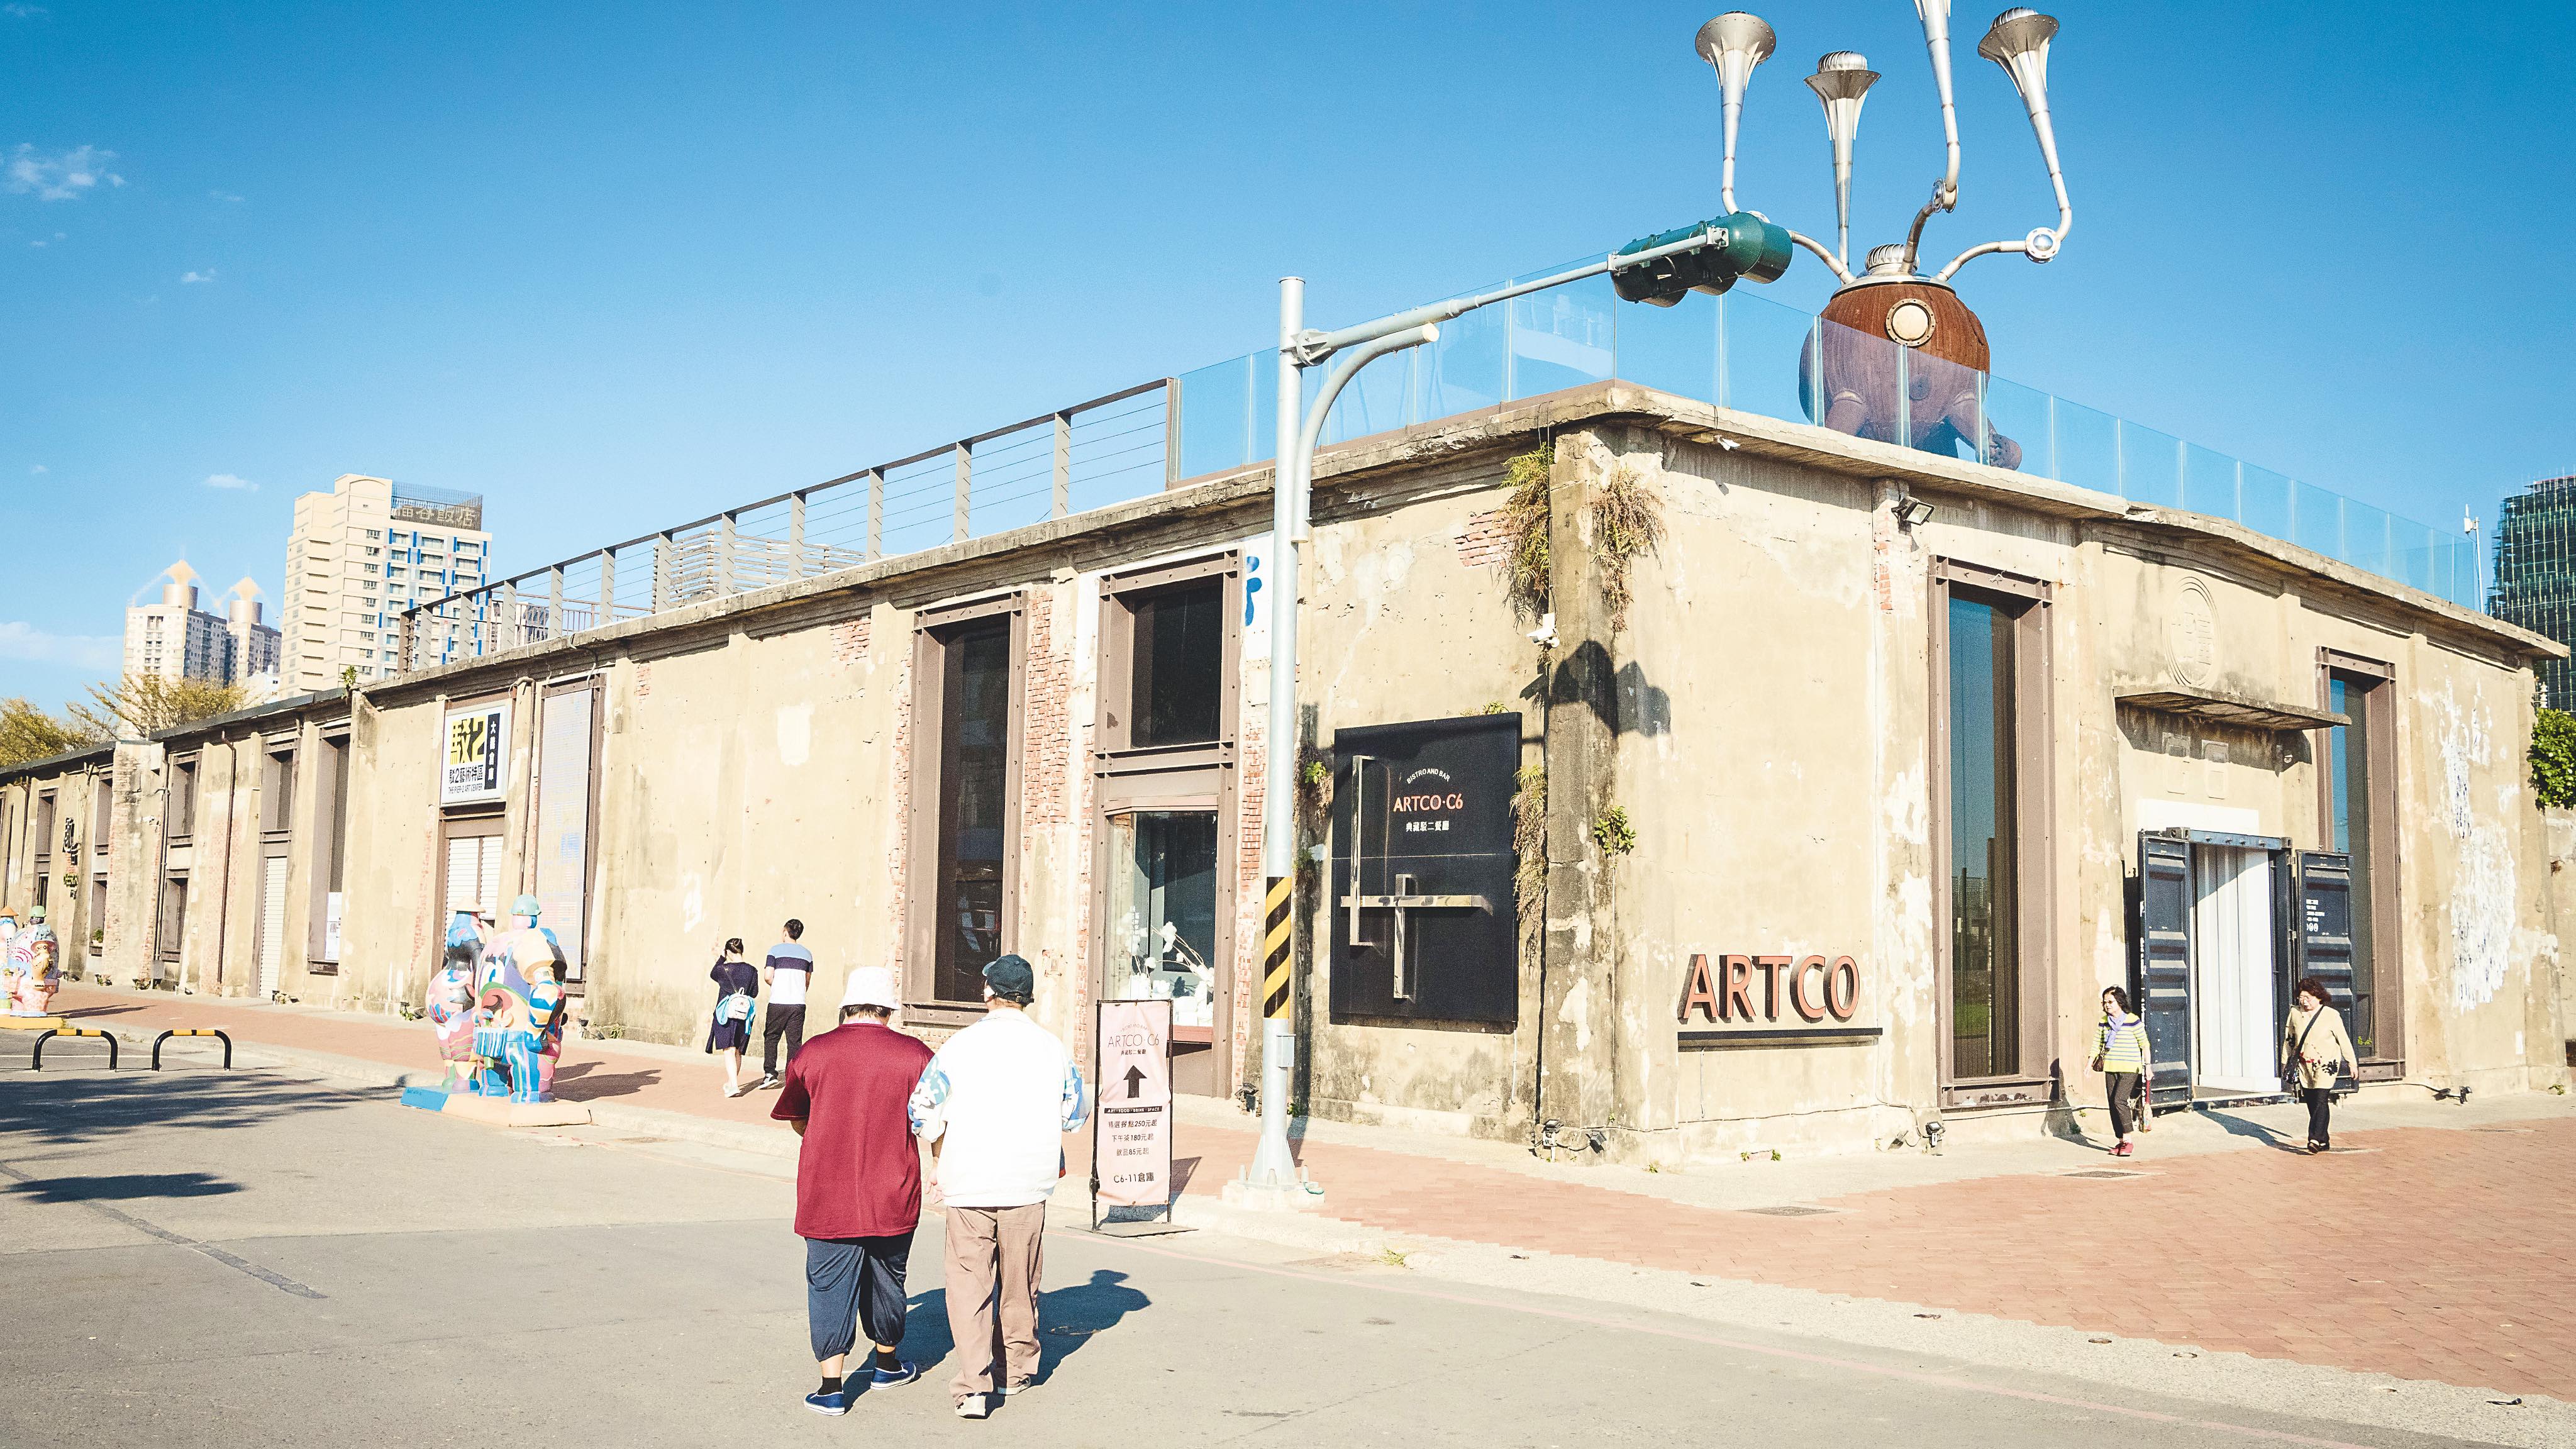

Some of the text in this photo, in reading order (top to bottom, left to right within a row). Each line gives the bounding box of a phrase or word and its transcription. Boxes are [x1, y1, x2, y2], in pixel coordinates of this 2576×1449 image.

[1406, 769, 1427, 784] BISTRO
[1438, 770, 1450, 782] BAR
[1677, 954, 1860, 1024] ARTCO
[1112, 1133, 1154, 1143] 下午茶180元起
[1116, 1147, 1150, 1157] 飲品85元起
[1113, 1172, 1155, 1184] C6-11倉庫
